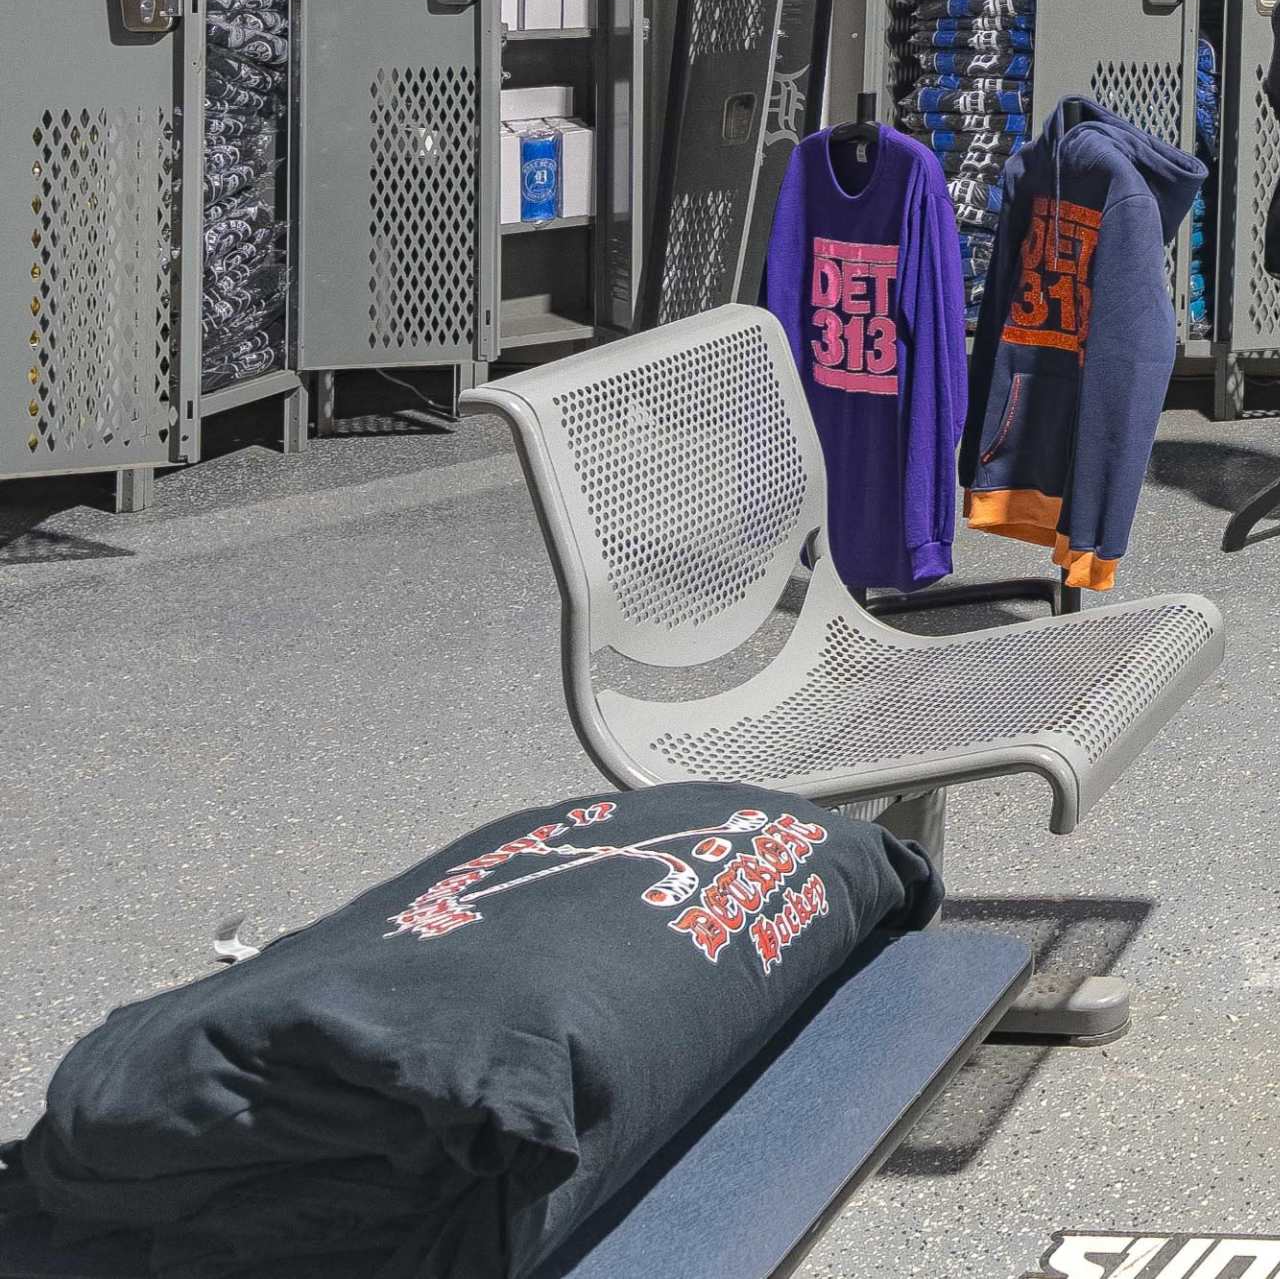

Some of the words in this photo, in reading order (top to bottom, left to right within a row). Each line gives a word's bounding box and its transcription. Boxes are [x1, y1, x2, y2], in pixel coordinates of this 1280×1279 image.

[1020, 217, 1102, 284] DET
[811, 257, 899, 317] DET
[810, 308, 898, 376] 313
[748, 873, 830, 976] Hockey
